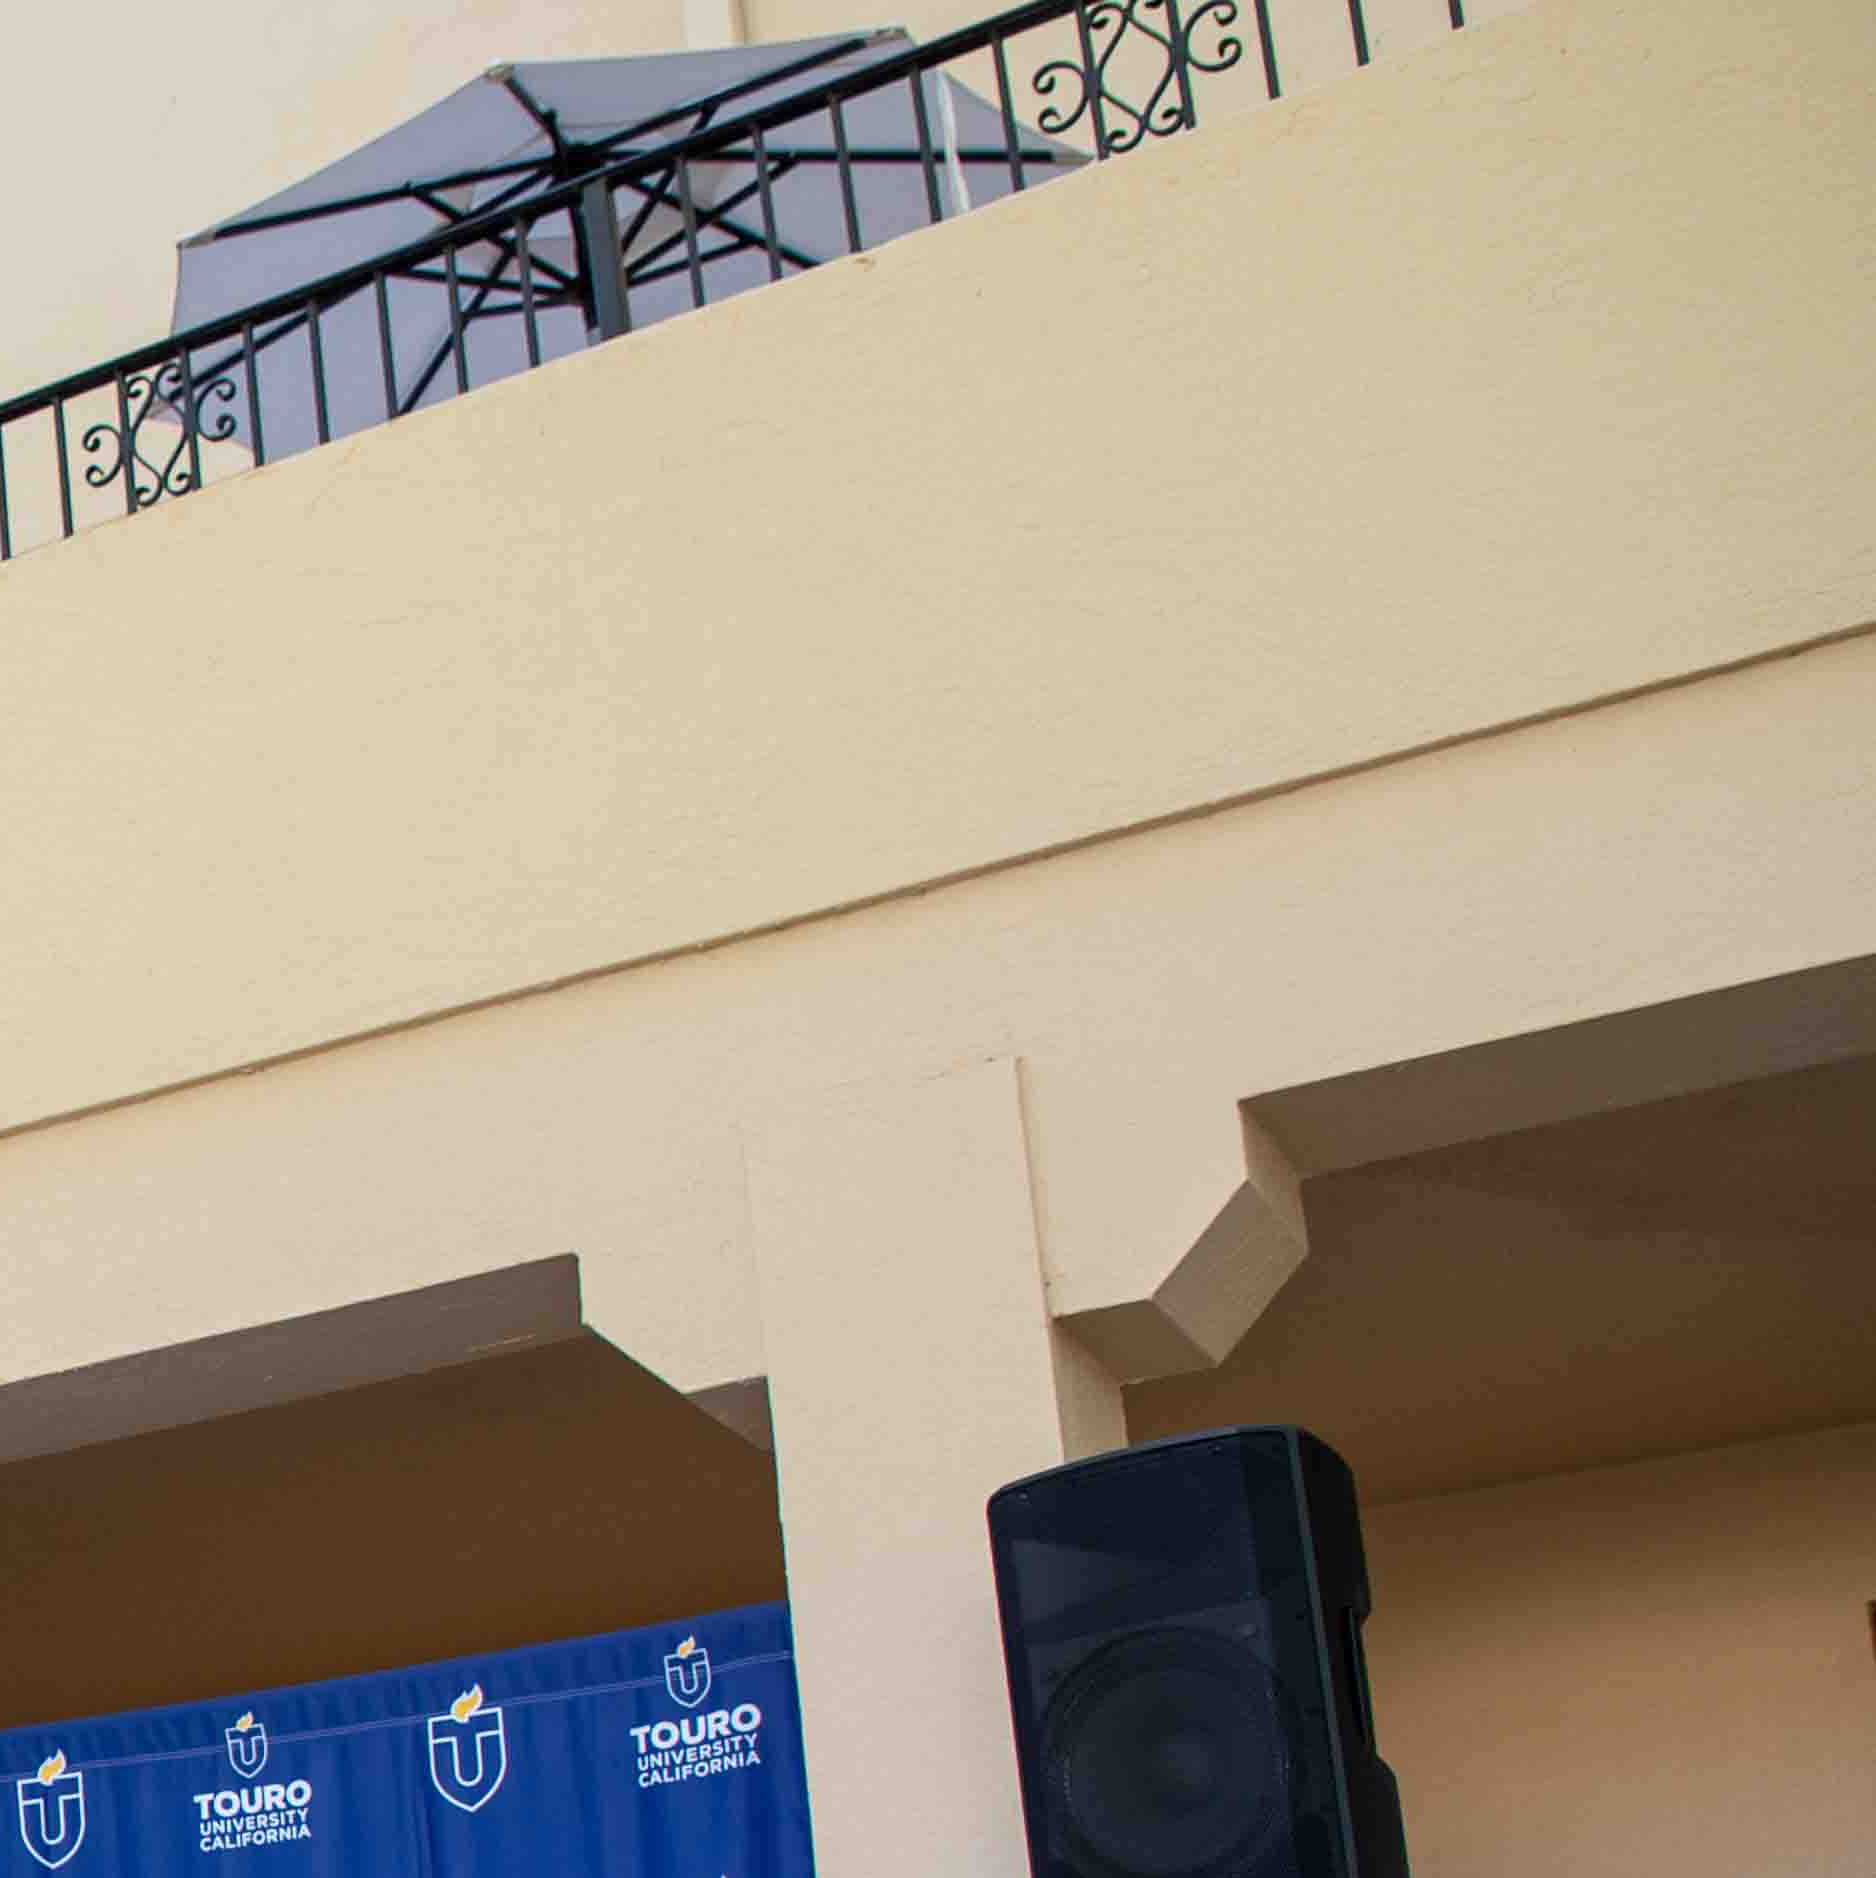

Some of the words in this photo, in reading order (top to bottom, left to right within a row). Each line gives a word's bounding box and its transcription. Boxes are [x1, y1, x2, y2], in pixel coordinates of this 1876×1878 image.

[630, 1703, 761, 1753] TOURO
[638, 1733, 757, 1770] UNIVERSITY
[639, 1751, 760, 1787] CALIFORNIA
[194, 1780, 312, 1819] TOURO
[200, 1808, 308, 1836] UNIVERSITY
[200, 1824, 311, 1851] CALIFORNIA
